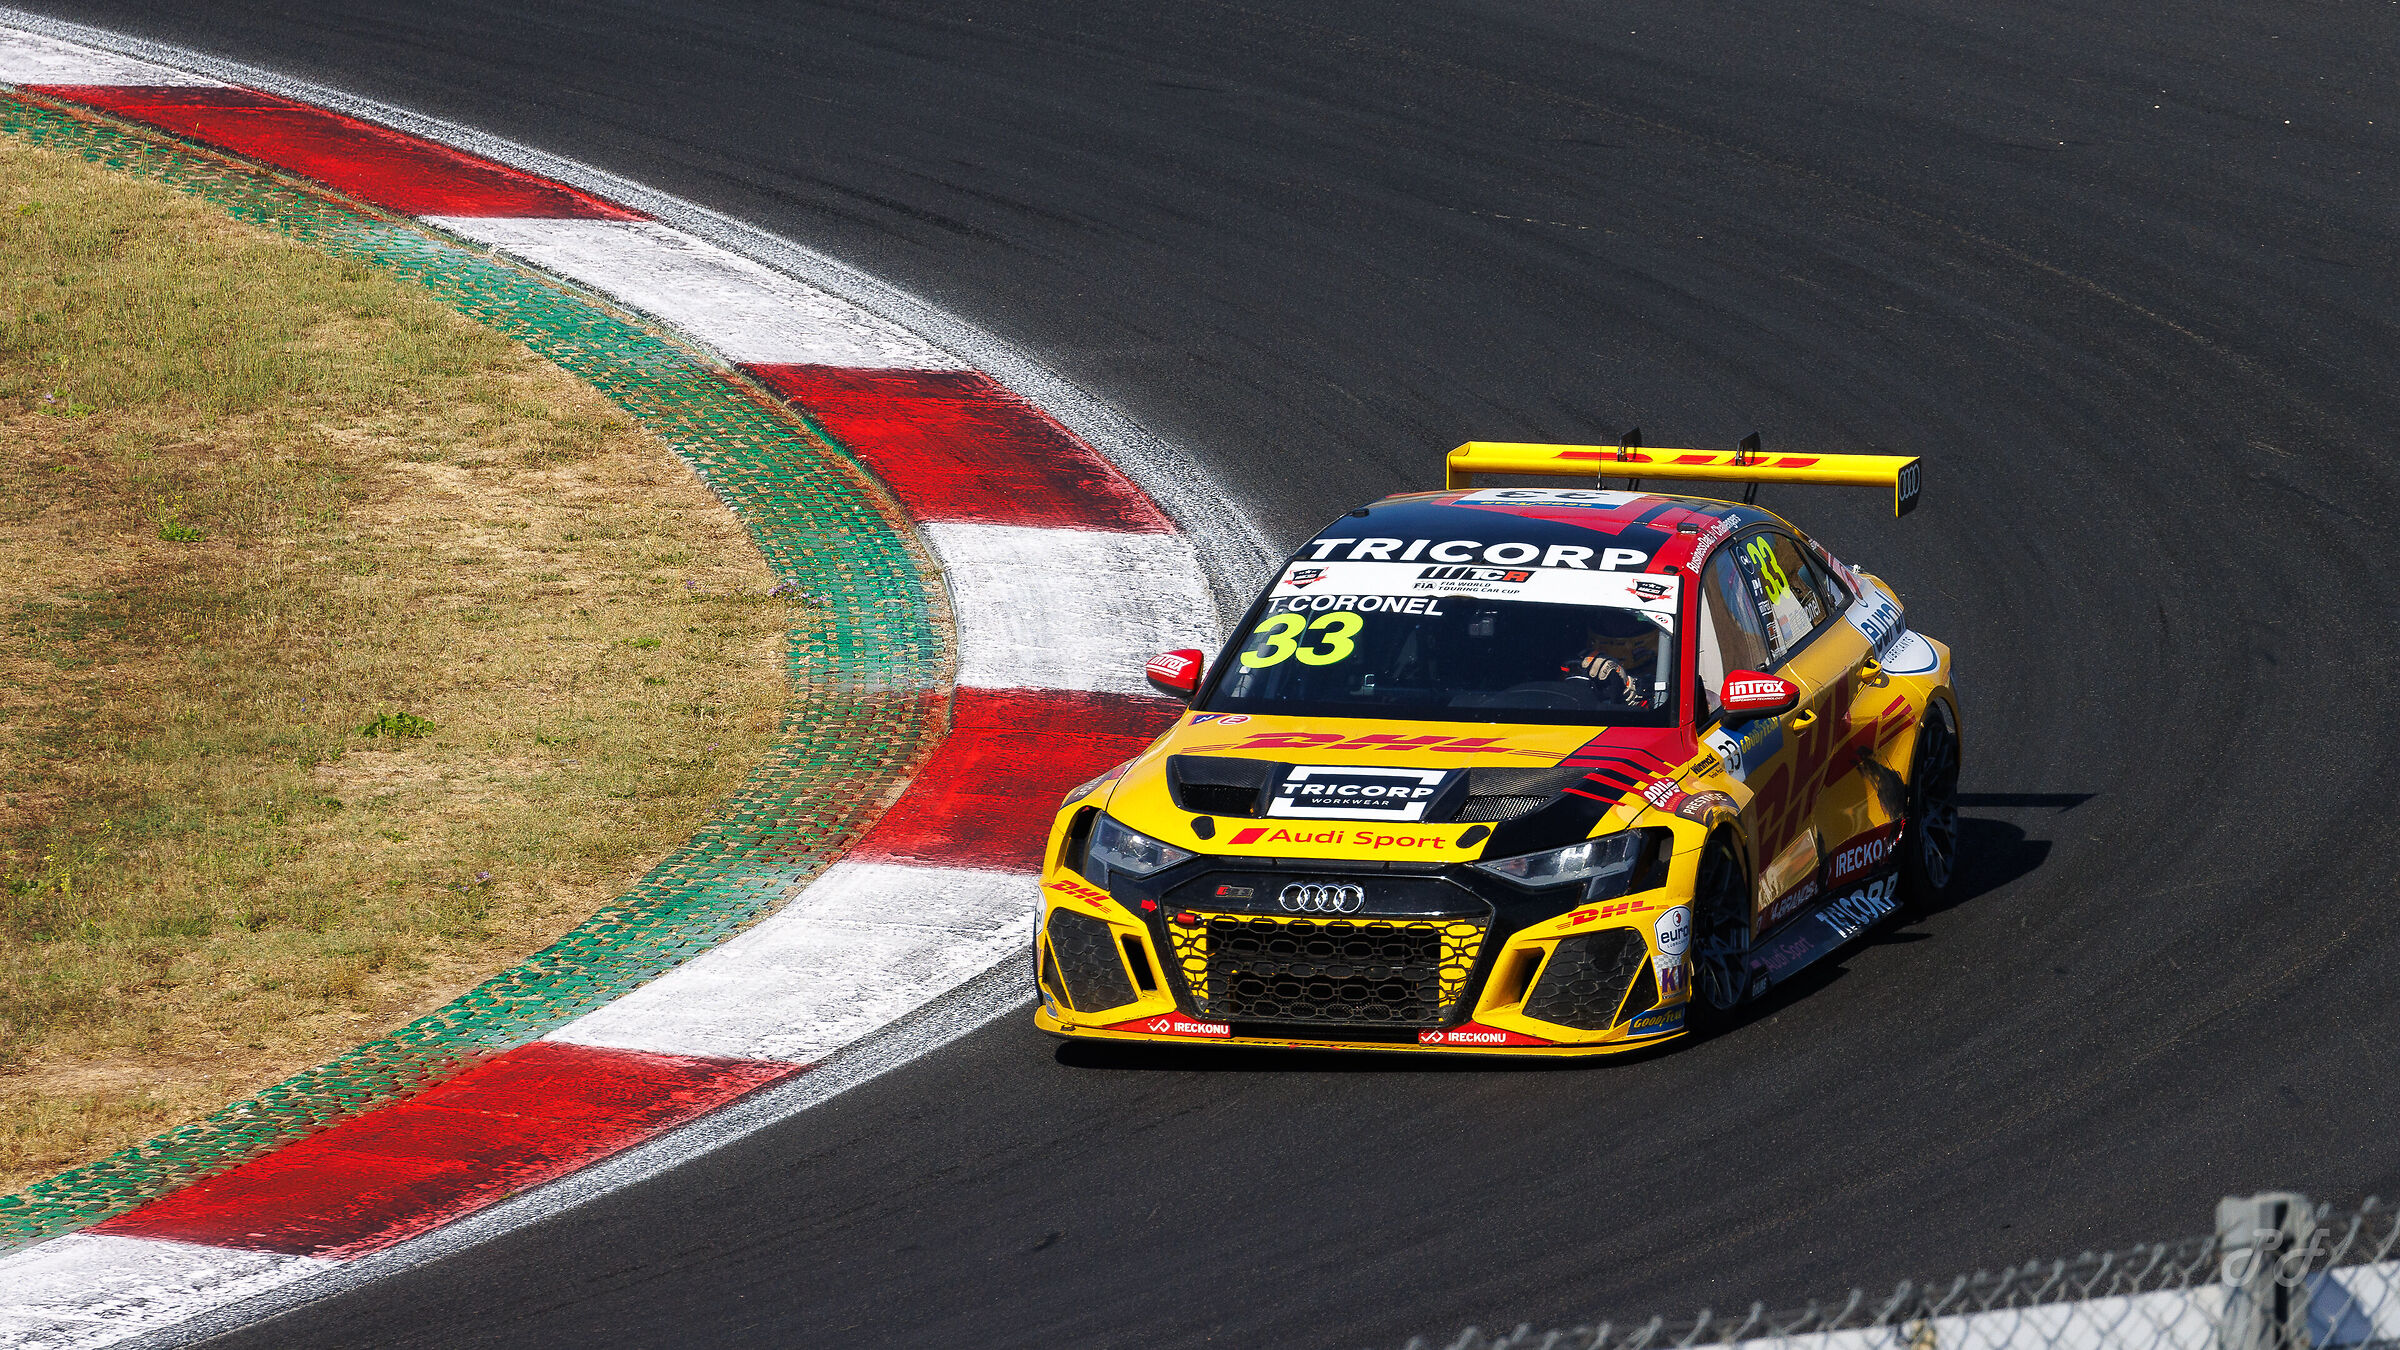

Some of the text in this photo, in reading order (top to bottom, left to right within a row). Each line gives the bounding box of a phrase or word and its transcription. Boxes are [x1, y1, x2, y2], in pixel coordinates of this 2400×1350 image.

[1310, 538, 1648, 571] TRICORP
[1747, 536, 1790, 606] 33
[1268, 594, 1443, 616] T.CORONEL
[1240, 611, 1364, 669] 33
[1729, 680, 1785, 696] inTrax
[1231, 733, 1515, 753] DHL
[1718, 740, 1741, 775] 33
[1281, 783, 1435, 799] TRICORP
[1312, 798, 1390, 806] WORKWEAR
[1268, 829, 1446, 849] Audi Sport
[1568, 901, 1655, 926] DHL
[1174, 1022, 1229, 1034] IRECKONU
[1448, 1032, 1507, 1043] IRECKONU
